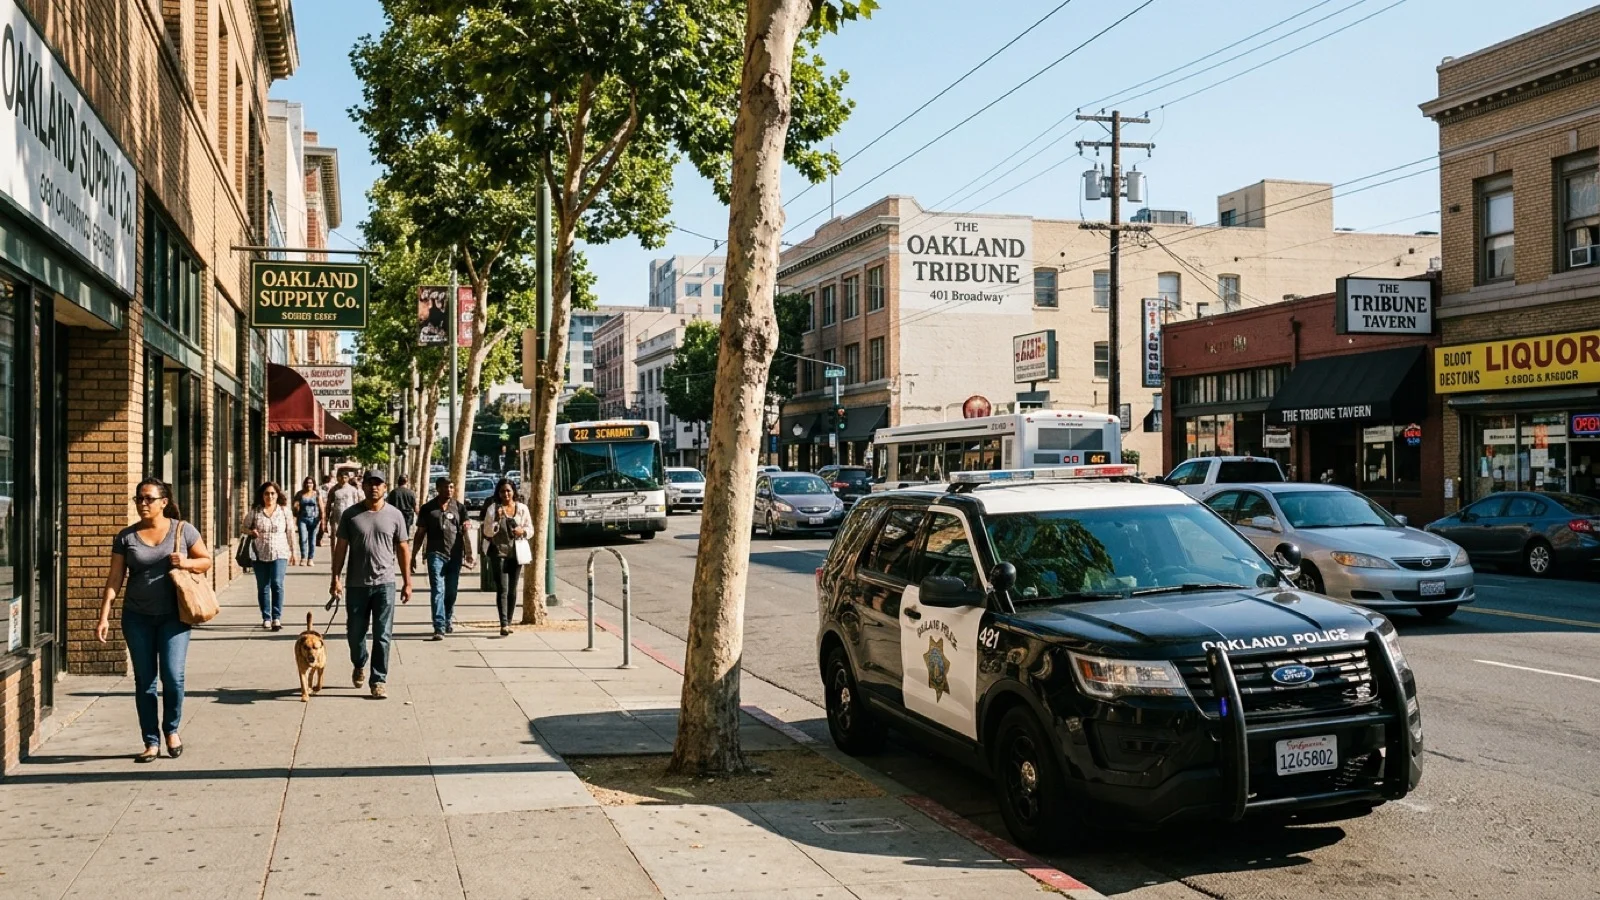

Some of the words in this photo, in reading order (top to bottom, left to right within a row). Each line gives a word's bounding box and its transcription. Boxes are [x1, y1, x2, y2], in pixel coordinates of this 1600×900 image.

[2, 22, 77, 174] OAKLAND
[79, 120, 120, 221] SUPPLY
[120, 170, 135, 237] Co.
[954, 222, 978, 232] THE
[907, 234, 1025, 258] OAKLAND
[262, 270, 358, 289] OAKLAND
[913, 261, 1020, 284] TRIBUNE
[930, 290, 948, 300] 401
[951, 291, 1003, 304] Broadway
[1378, 283, 1399, 293] THE
[260, 289, 329, 308] SUPPLY
[333, 291, 360, 309] Co.
[1351, 295, 1427, 313] TRIBUNE
[1363, 315, 1416, 328] TAVERN
[1444, 351, 1472, 367] BLOOT
[1485, 335, 1600, 372] LIQUOR
[1282, 410, 1298, 422] THE
[1337, 405, 1372, 418] TAVERN
[979, 627, 1000, 649] 421
[1201, 635, 1288, 651] OAKLAND
[1280, 749, 1334, 770] 1265802
